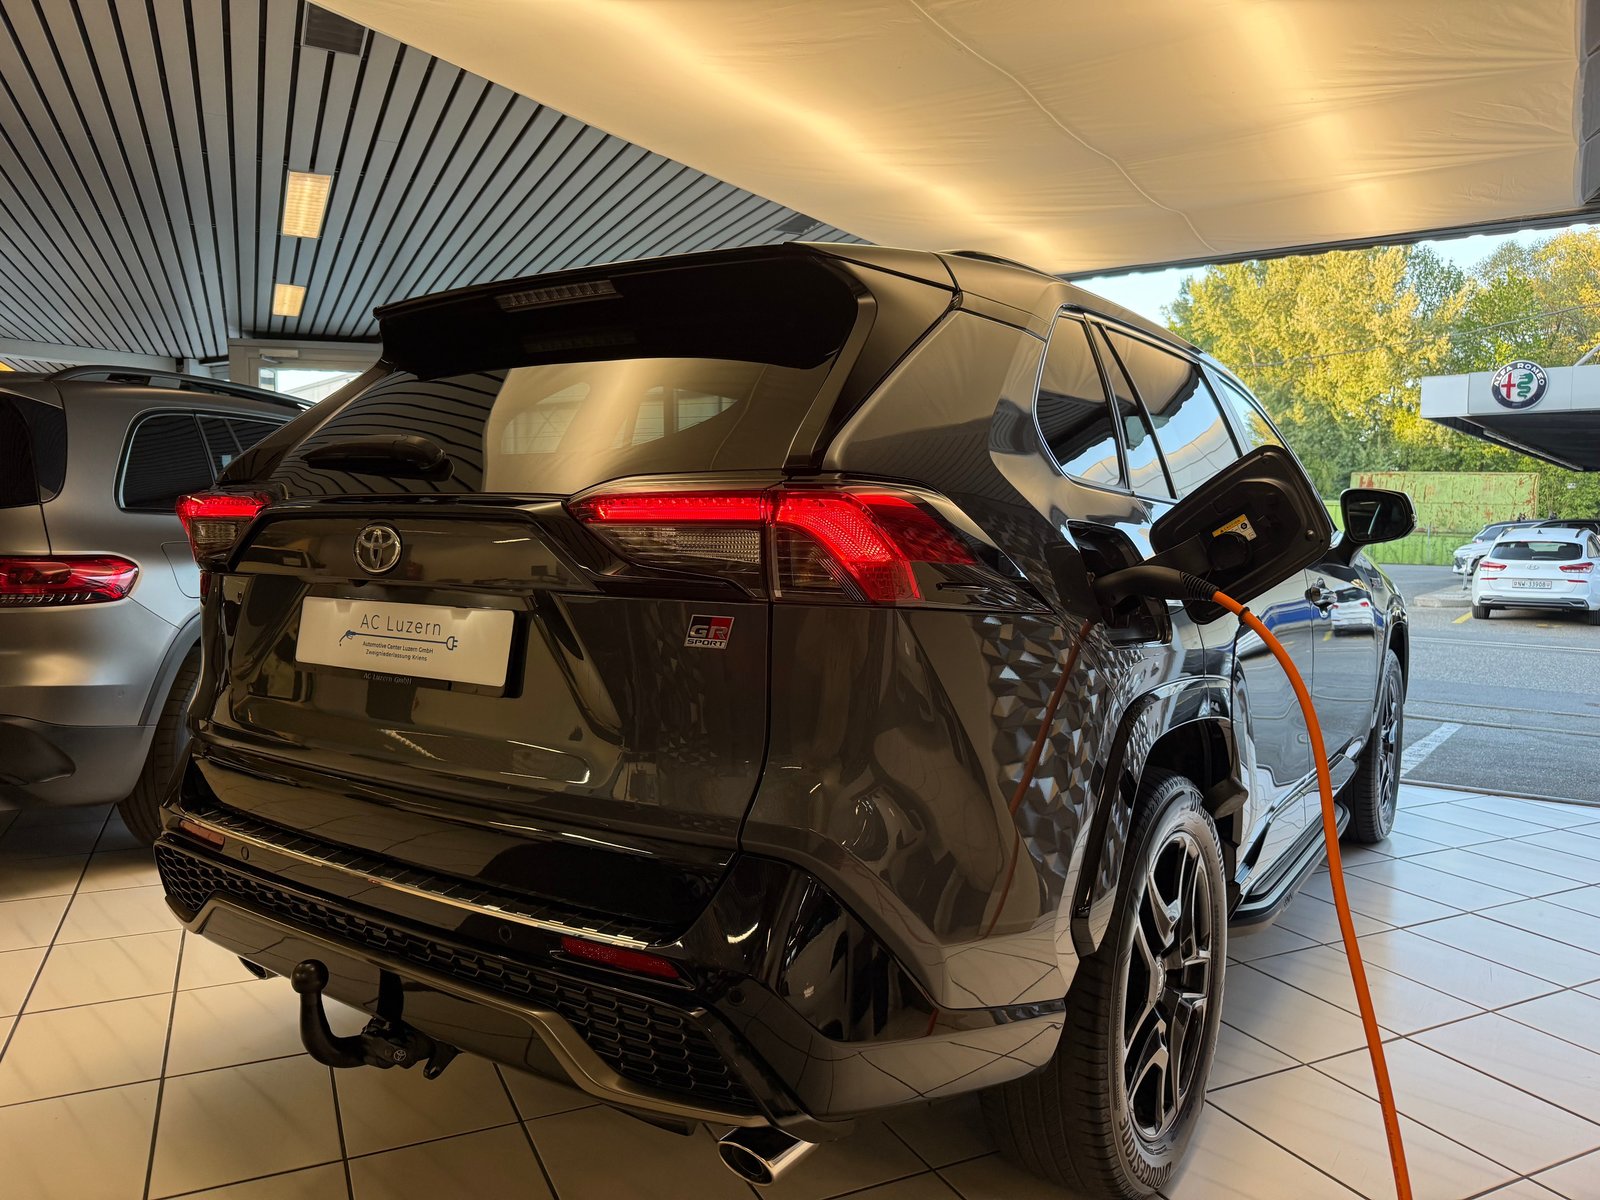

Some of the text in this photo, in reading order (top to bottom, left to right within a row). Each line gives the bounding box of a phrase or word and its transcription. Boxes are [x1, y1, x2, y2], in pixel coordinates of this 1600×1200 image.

[1493, 362, 1545, 387] ALFA ROMEO
[360, 614, 441, 635] AC Luzern
[690, 625, 729, 639] GR
